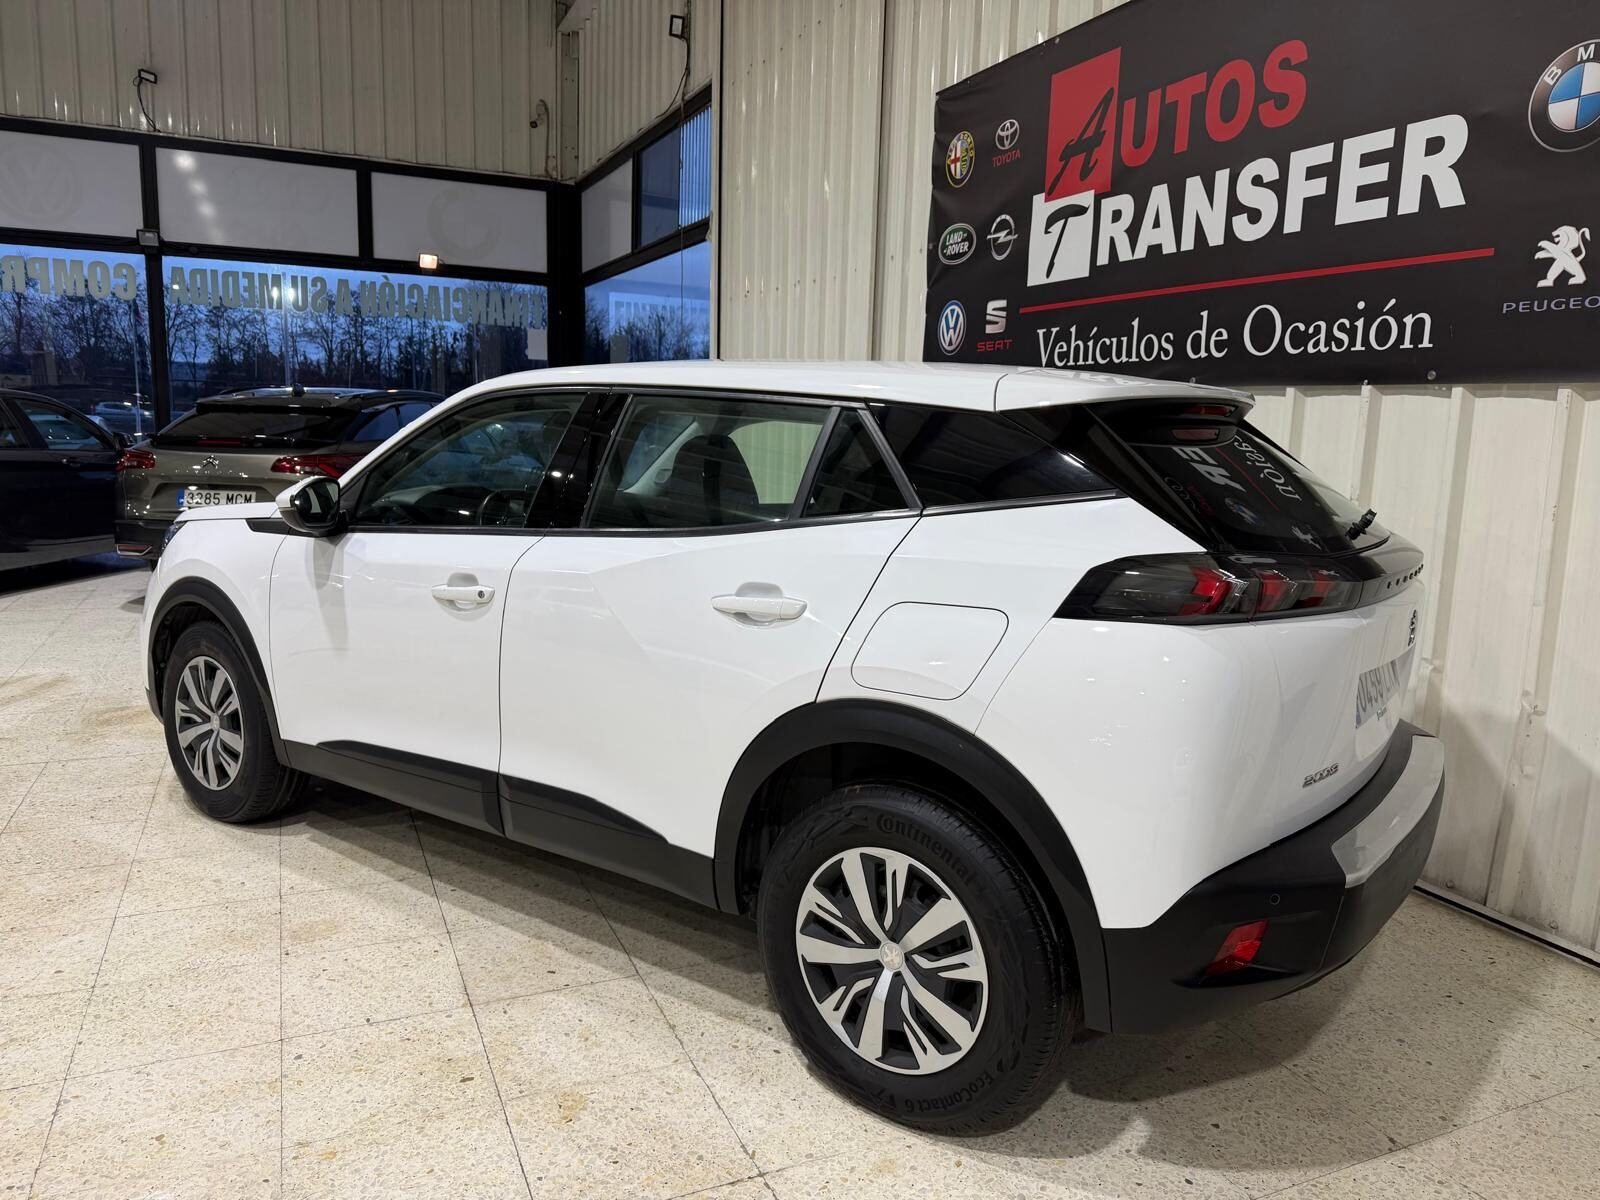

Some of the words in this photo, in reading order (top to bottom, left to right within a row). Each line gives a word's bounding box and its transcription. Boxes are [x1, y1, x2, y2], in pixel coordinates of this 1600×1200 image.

[1046, 39, 1309, 199] AUTOS
[992, 149, 1021, 167] TOYOTA
[1029, 114, 1469, 284] TRANSFER
[977, 339, 1013, 352] SEAT
[1037, 316, 1174, 368] Vehículos
[1186, 310, 1229, 359] de
[1243, 298, 1433, 356] Ocasión
[186, 492, 221, 505] 3285
[226, 493, 253, 505] MCM
[877, 812, 977, 886] Continental
[917, 1069, 994, 1113] EcoContact
